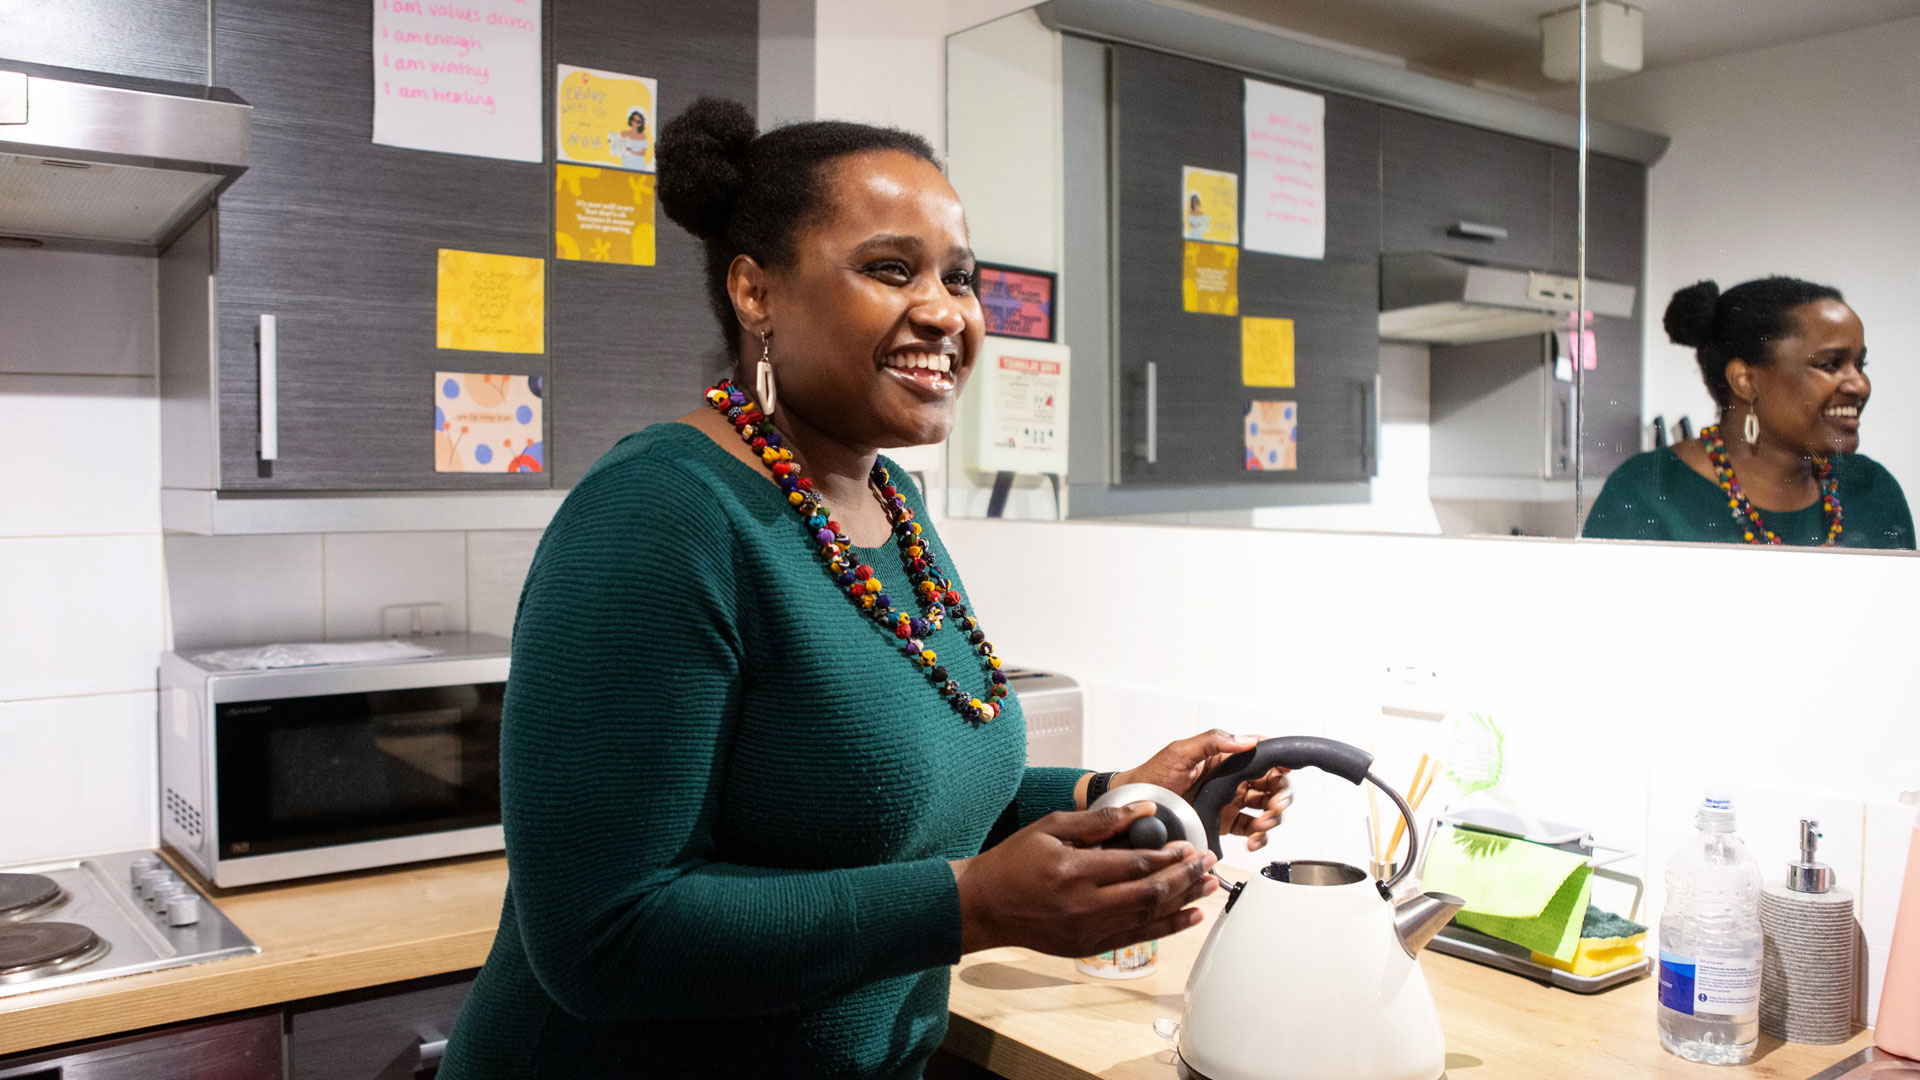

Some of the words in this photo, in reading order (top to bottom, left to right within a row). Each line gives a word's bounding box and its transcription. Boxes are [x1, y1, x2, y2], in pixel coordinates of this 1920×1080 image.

[393, 1, 423, 16] am
[429, 5, 482, 22] values
[487, 12, 535, 32] driven
[394, 29, 422, 43] am
[425, 33, 483, 57] enough
[395, 58, 426, 71] am
[430, 61, 489, 85] worthy
[398, 86, 429, 101] am
[433, 87, 496, 115] healing
